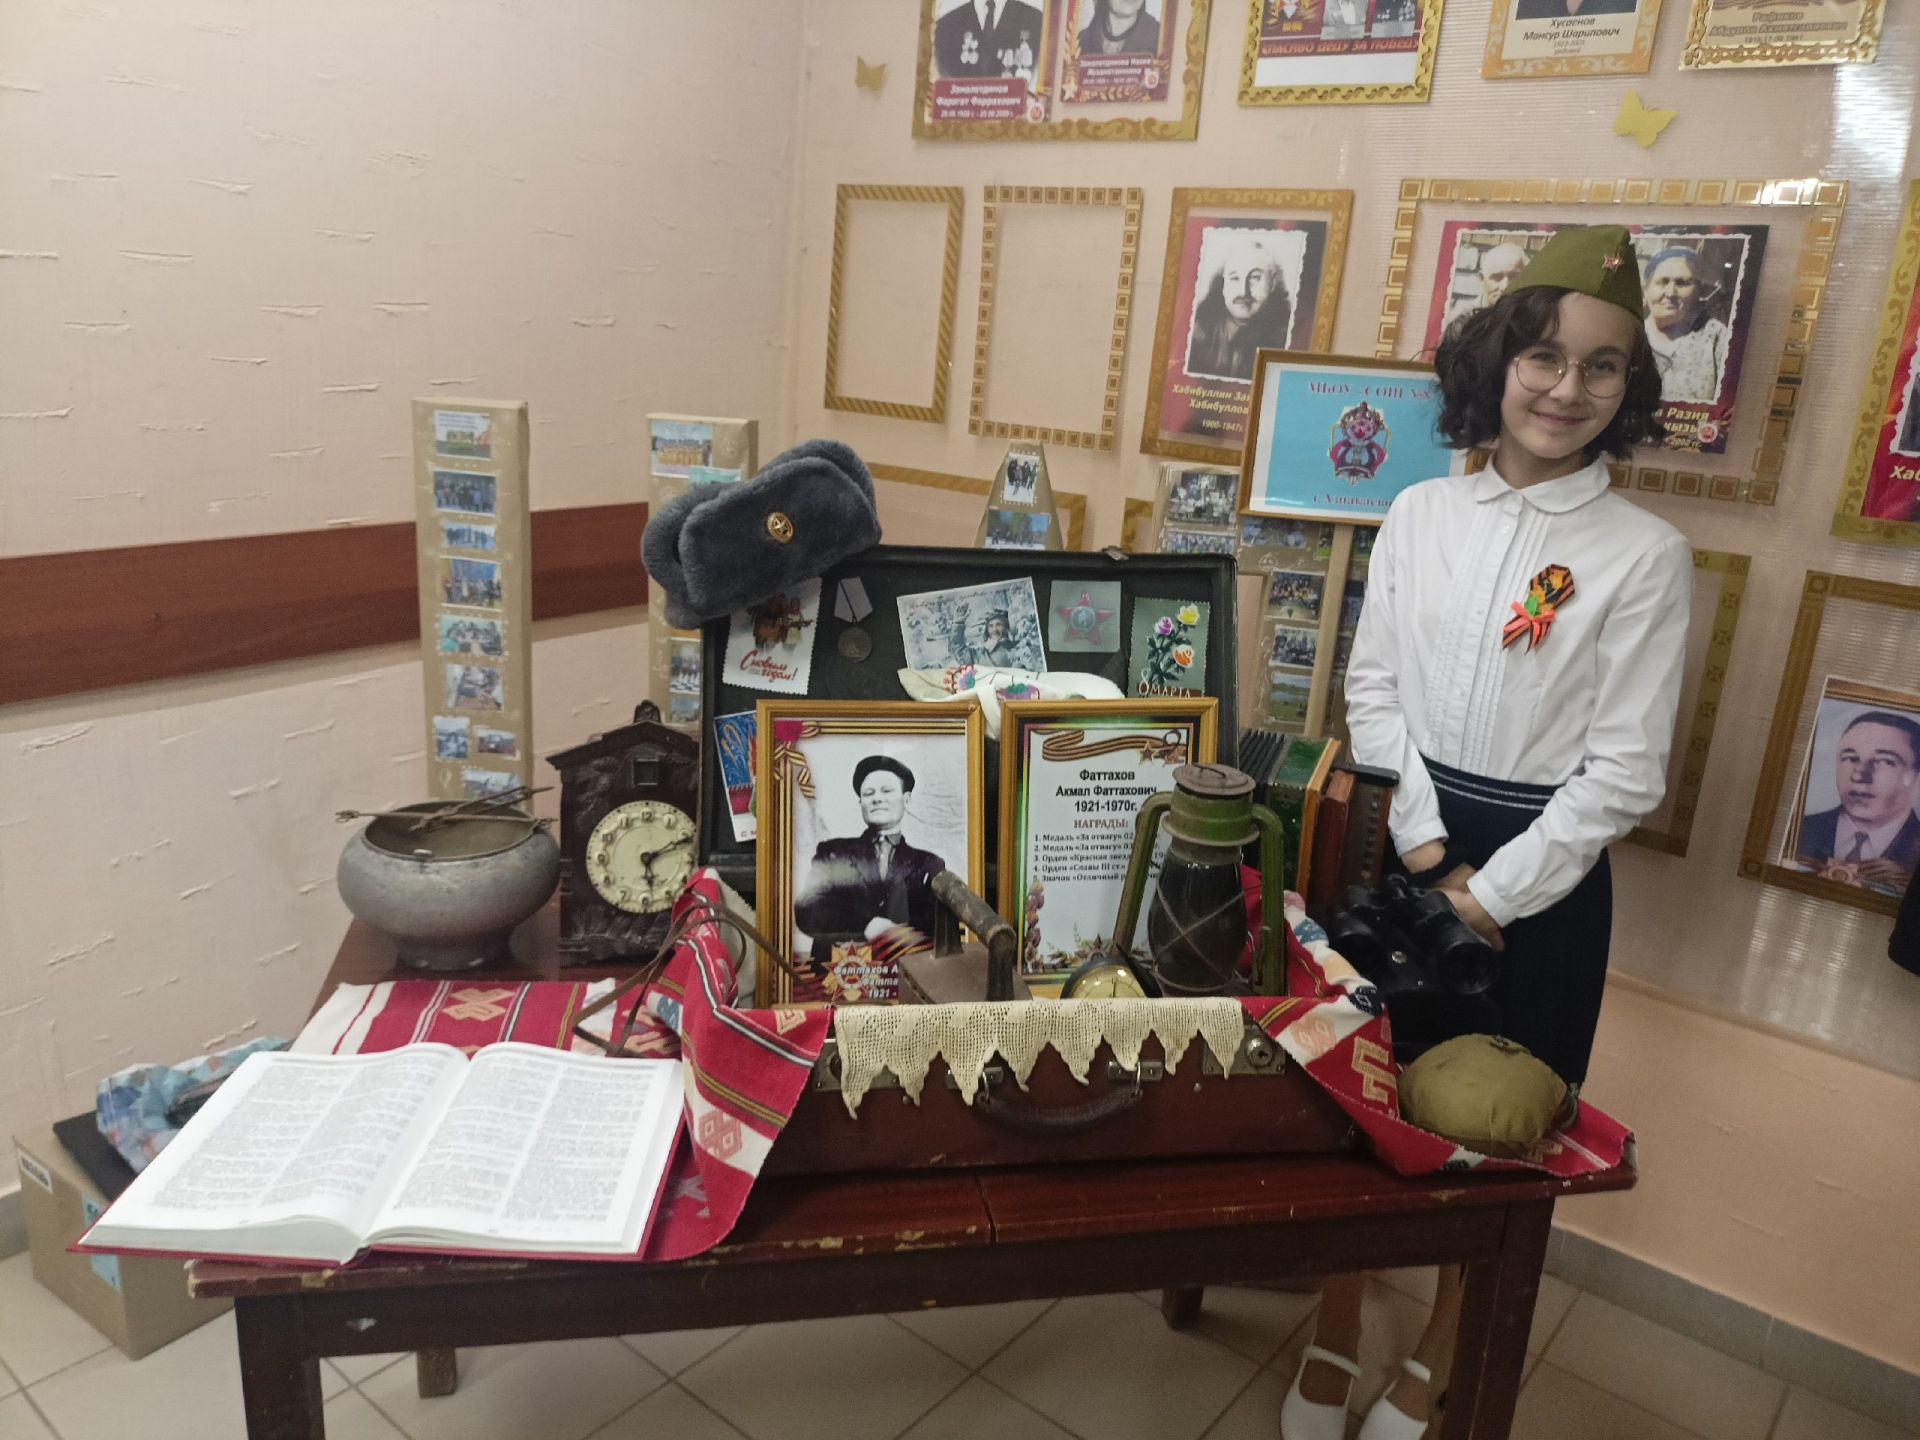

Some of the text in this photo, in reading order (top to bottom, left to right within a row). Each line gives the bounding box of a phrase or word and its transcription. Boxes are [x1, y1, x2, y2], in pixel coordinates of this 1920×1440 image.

[1523, 28, 1620, 41] Мансур Шарипович
[1172, 384, 1233, 399] Хабибуллин
[1667, 407, 1710, 420] Разия
[1151, 683, 1192, 699] МАРТА
[1079, 769, 1136, 781] Фаттахов
[1055, 785, 1157, 797] Акмал Фаттахович
[1074, 801, 1138, 812] 1921-1970г.
[641, 811, 653, 823] 12
[1073, 818, 1129, 829] НАГРАДЫ:
[1043, 834, 1074, 842] Медаль
[1091, 834, 1122, 843] отвагу»
[1042, 845, 1074, 853] Медаль
[1090, 844, 1122, 853] отвагу»
[1042, 855, 1068, 863] Орден
[1070, 853, 1108, 862] «Красная
[1042, 865, 1068, 873] Орден
[1070, 864, 1099, 872] «Славы
[868, 988, 890, 998] 1921
